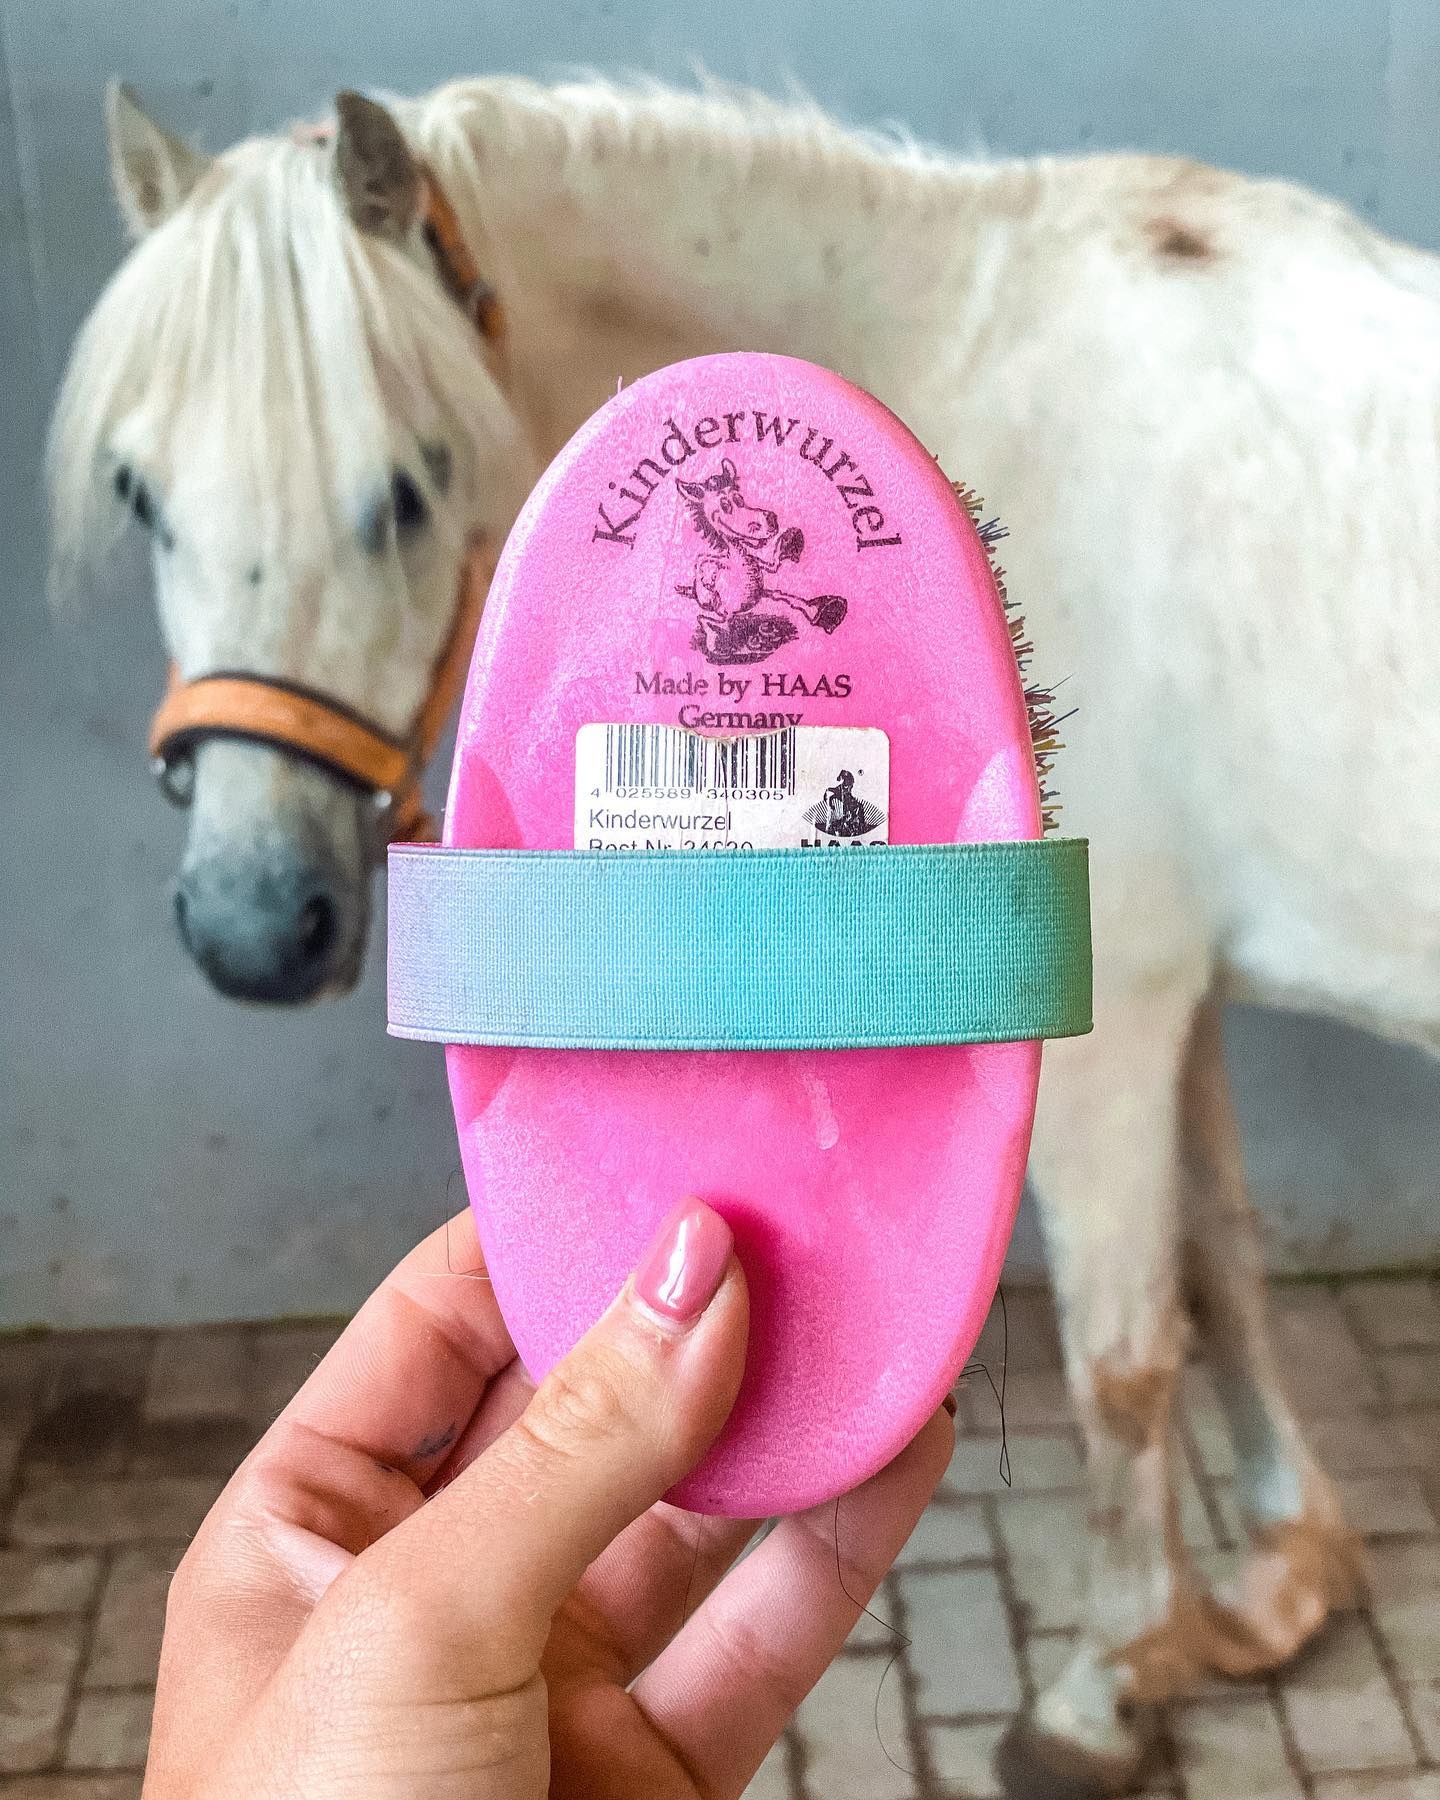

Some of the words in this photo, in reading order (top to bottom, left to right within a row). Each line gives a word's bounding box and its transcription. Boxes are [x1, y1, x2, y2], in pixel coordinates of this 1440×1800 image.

[592, 410, 902, 552] Kinderwurzel
[634, 671, 709, 696] Made
[718, 672, 751, 703] by
[761, 673, 852, 698] HAAS
[678, 704, 804, 729] Germany
[590, 787, 600, 798] 4
[616, 787, 691, 799] 025589
[707, 788, 784, 801] 340305
[589, 809, 732, 831] Kinderwurzel
